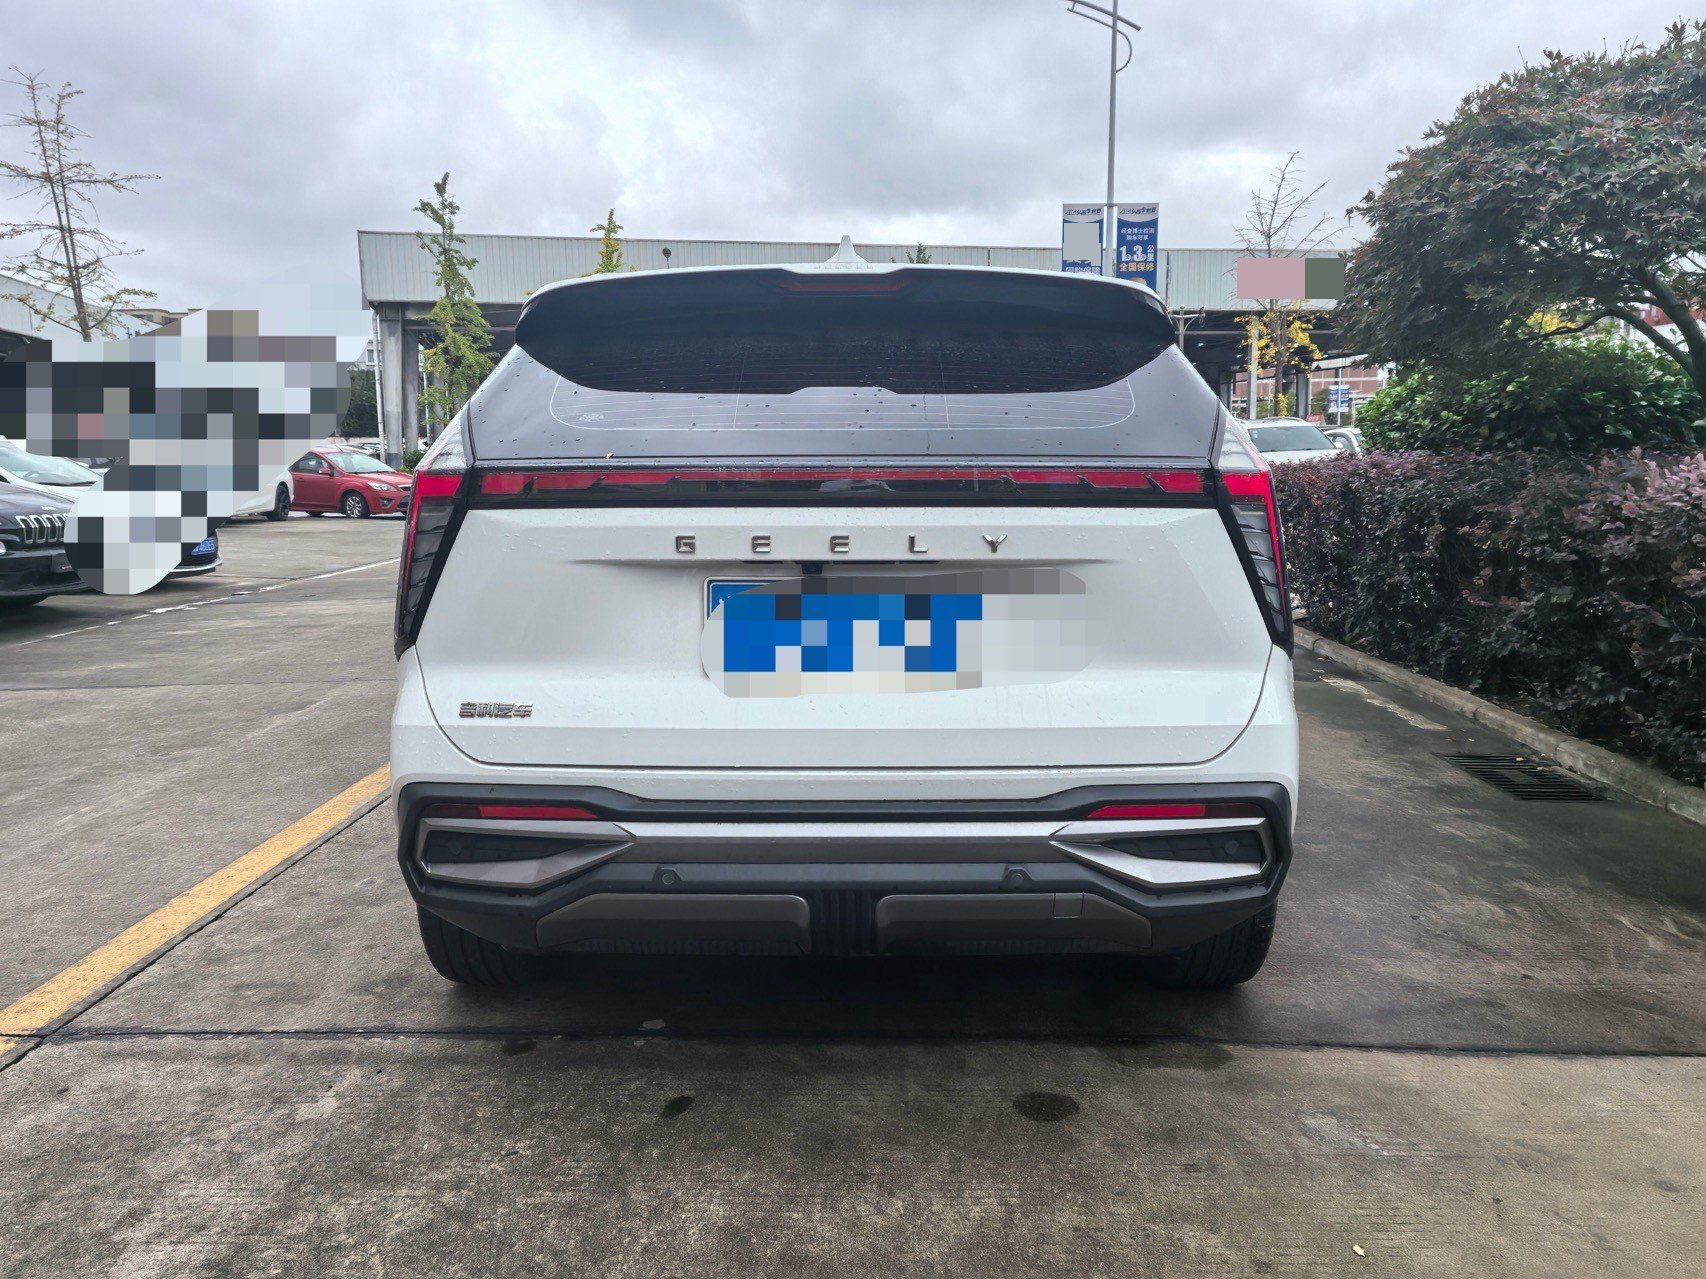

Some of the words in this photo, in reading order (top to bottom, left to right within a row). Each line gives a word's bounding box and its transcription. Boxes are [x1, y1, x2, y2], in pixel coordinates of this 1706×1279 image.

[1119, 262, 1155, 272] 全国保修
[675, 533, 1007, 553] GEELY
[459, 701, 533, 718] 吉利汽车
